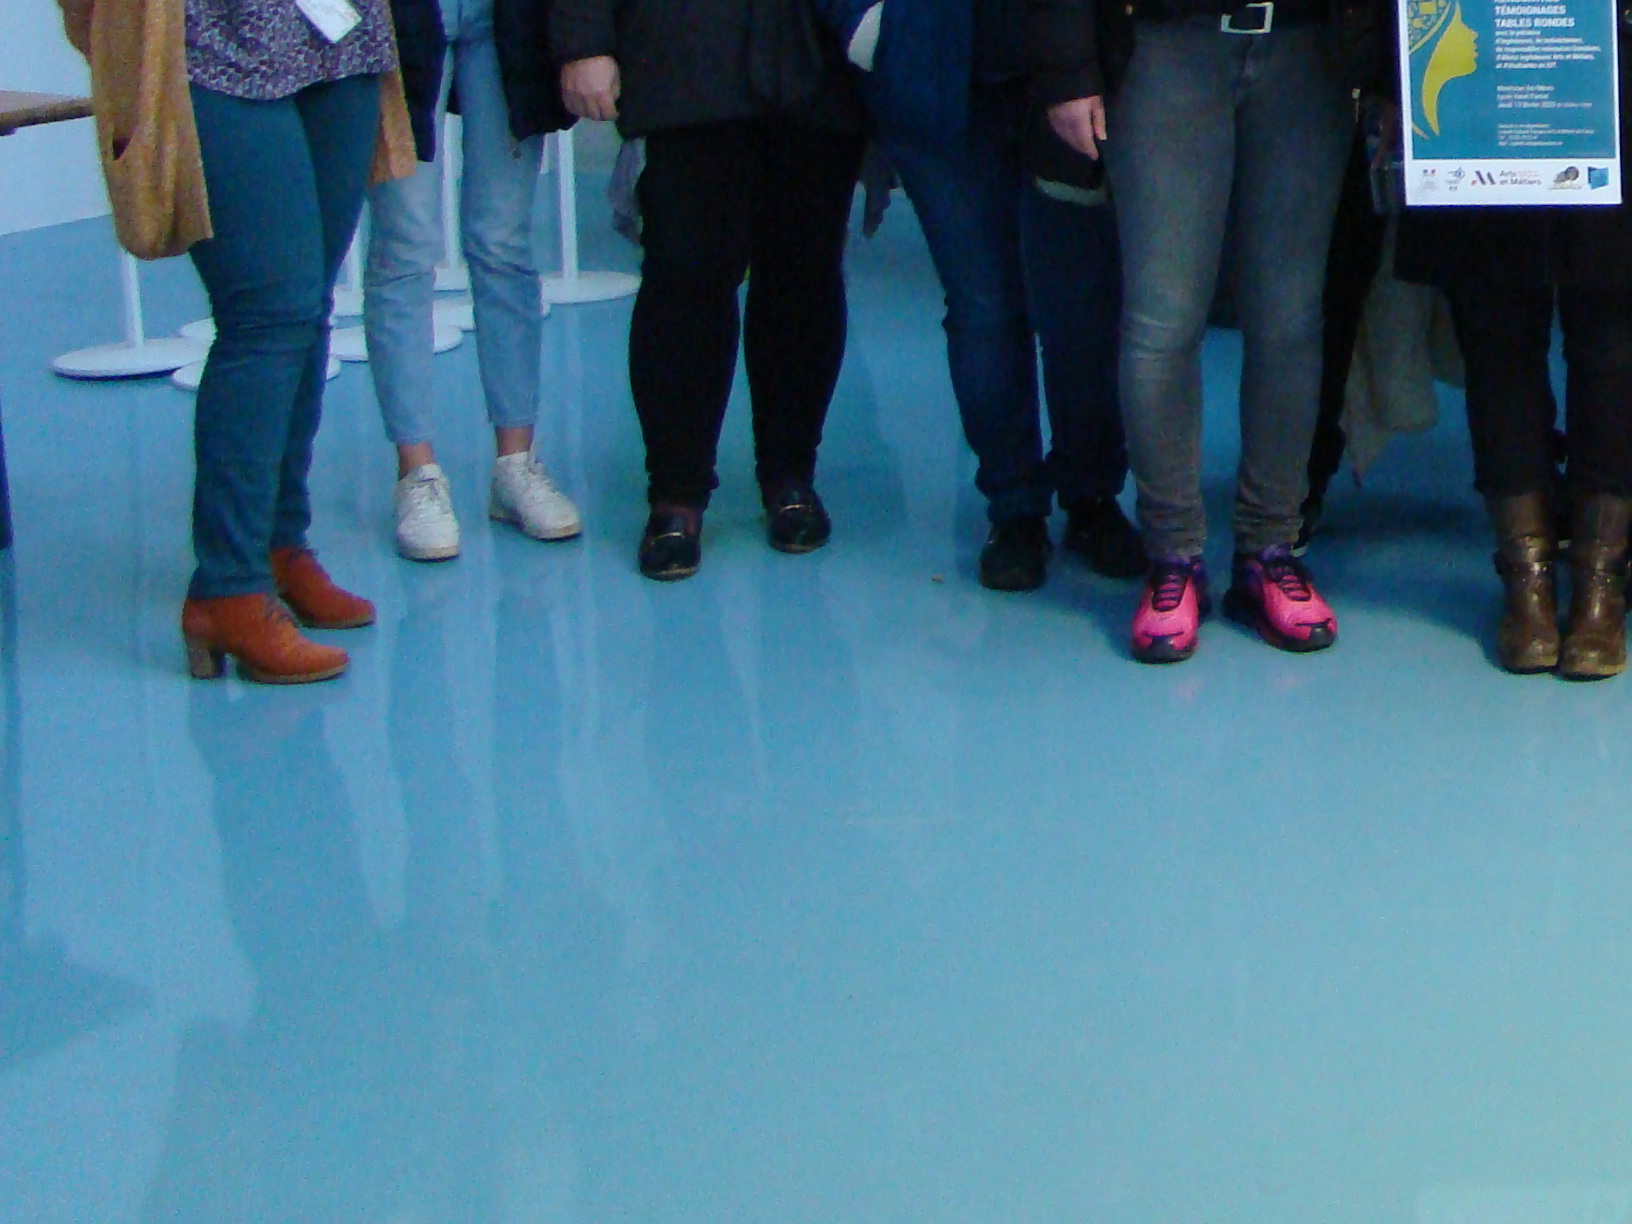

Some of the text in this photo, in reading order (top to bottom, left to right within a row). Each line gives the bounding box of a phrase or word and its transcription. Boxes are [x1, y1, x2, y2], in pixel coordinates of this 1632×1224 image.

[1494, 4, 1567, 16] TÉMOIGNAGES
[1494, 17, 1575, 27] TABLES RONDES
[1510, 176, 1542, 186] Métiers
